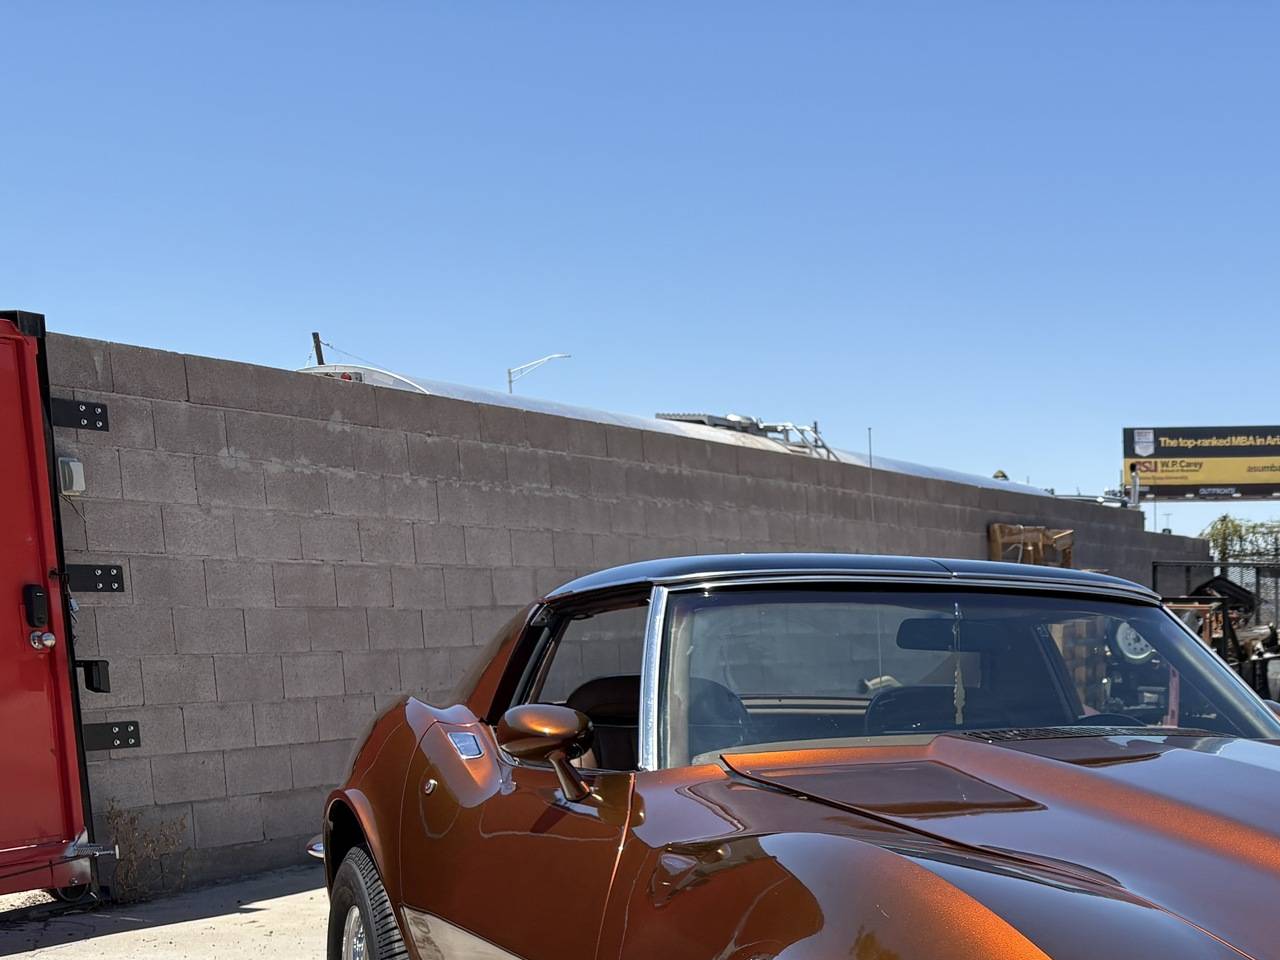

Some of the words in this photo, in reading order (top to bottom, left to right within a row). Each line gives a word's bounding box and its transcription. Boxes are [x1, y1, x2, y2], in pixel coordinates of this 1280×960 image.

[1158, 437, 1178, 448] The
[1178, 436, 1231, 449] top-ranked
[1231, 436, 1255, 447] MBA
[1256, 435, 1264, 446] in
[1179, 460, 1203, 470] Carey
